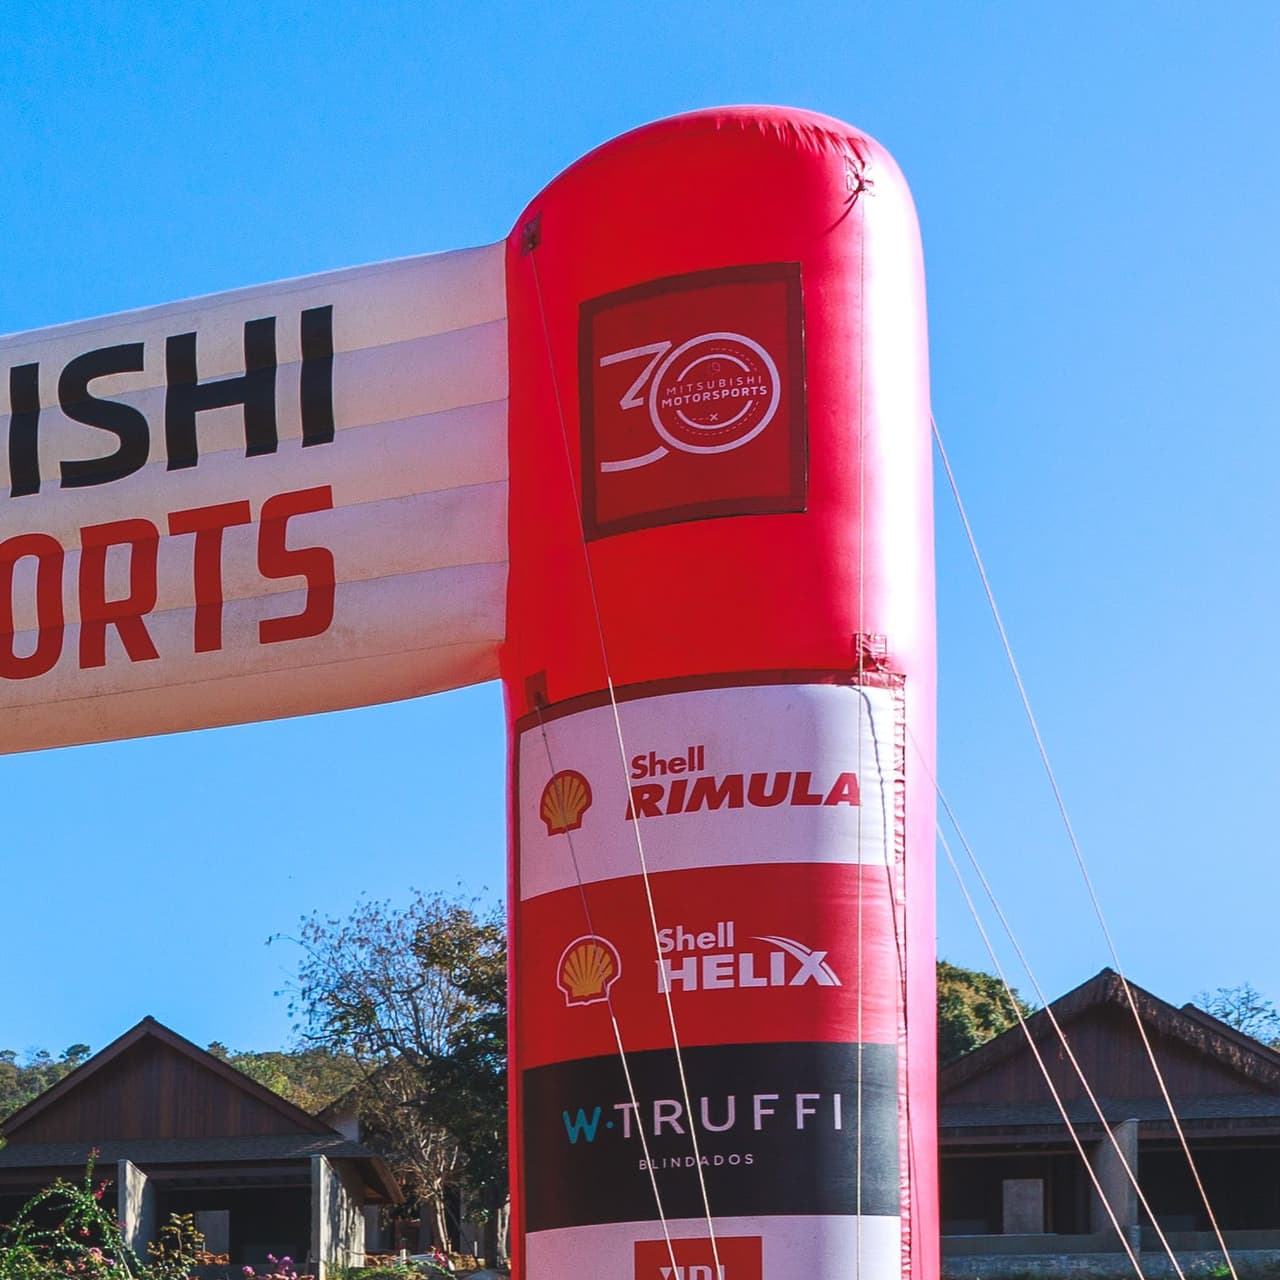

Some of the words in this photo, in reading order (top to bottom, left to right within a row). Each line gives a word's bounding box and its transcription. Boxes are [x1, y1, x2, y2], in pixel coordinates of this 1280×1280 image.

[661, 386, 768, 408] MOTORSPORTS
[666, 375, 763, 395] MITSUBISHI
[631, 745, 705, 780] Shell
[625, 772, 861, 821] RIMULA
[658, 921, 734, 952] Shell
[655, 942, 842, 994] HELIX
[639, 1153, 754, 1170] BLINDADOS
